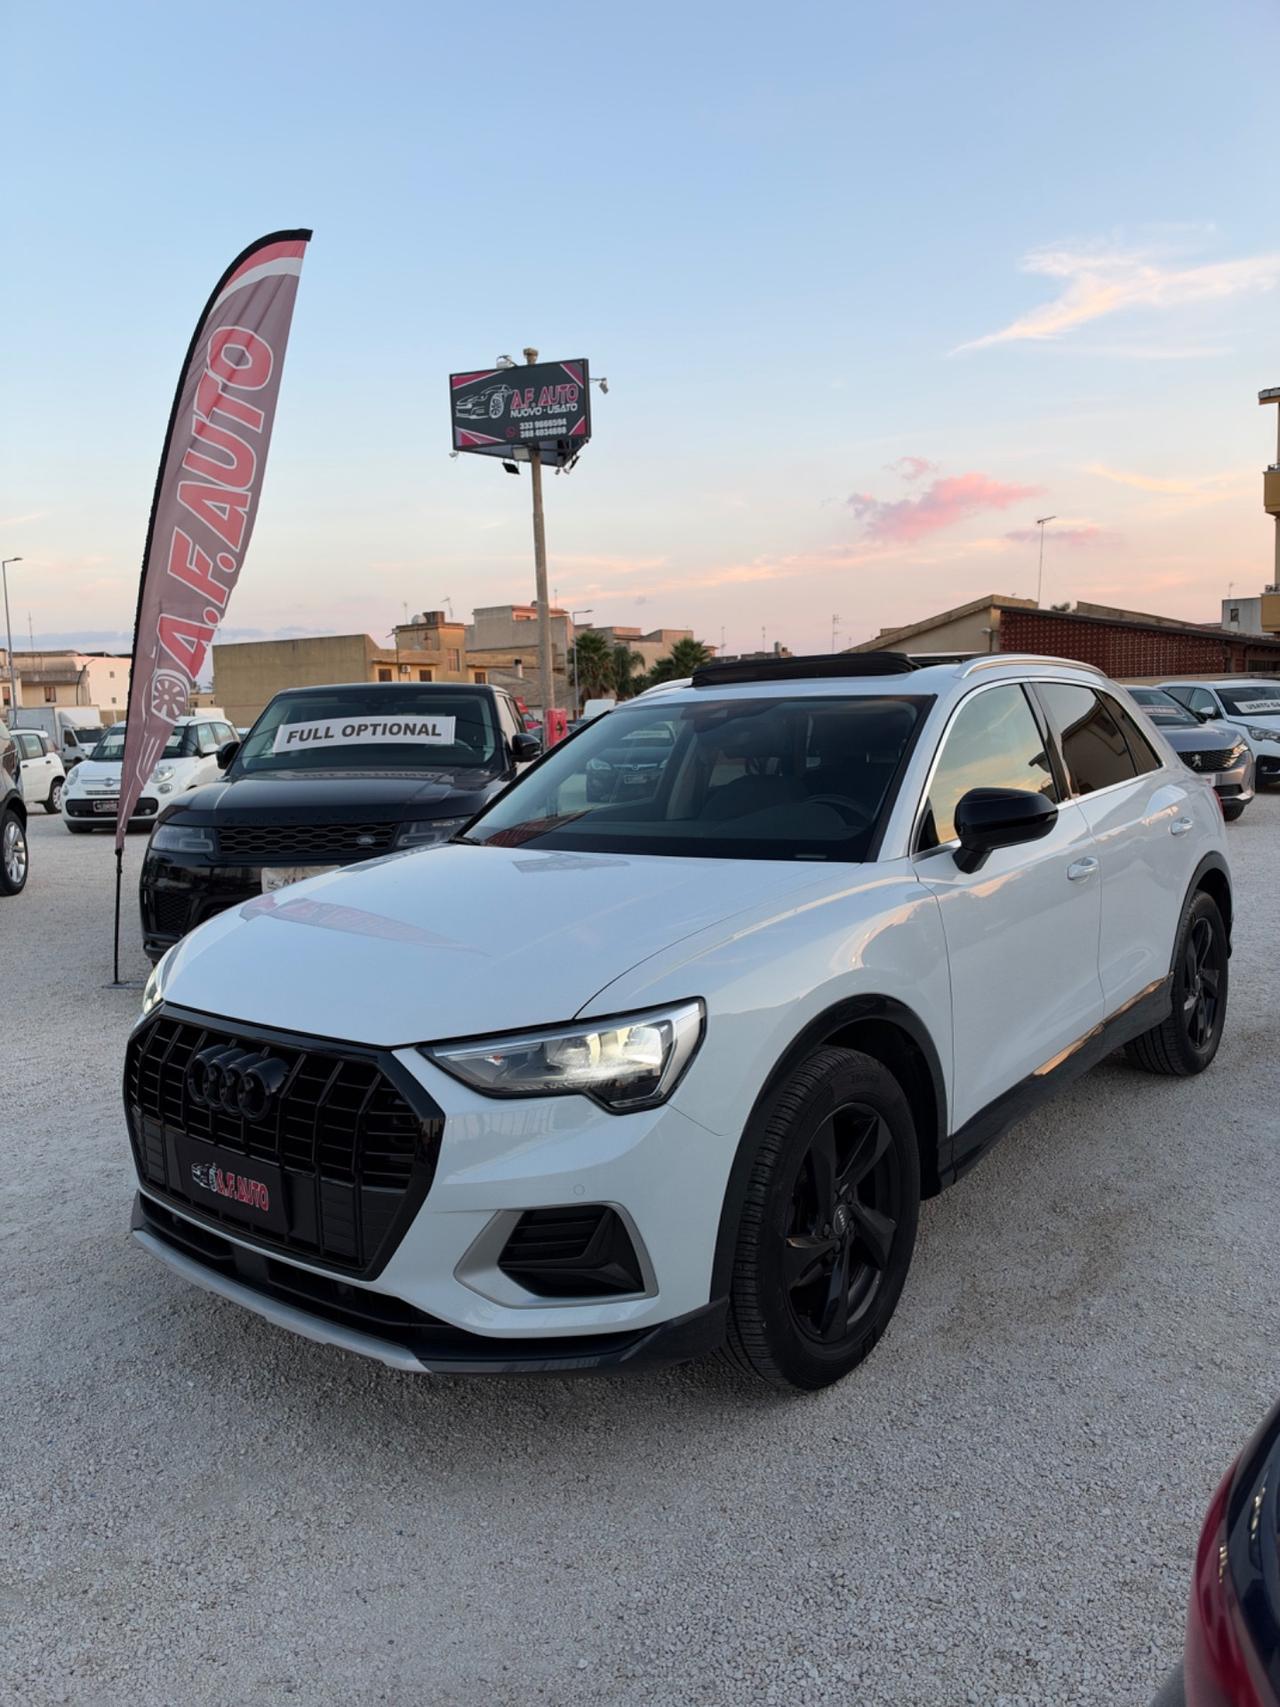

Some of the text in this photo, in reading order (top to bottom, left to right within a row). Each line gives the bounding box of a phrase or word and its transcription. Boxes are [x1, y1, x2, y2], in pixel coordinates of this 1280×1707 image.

[511, 403, 577, 418] NUOVO USATO
[286, 723, 442, 744] FULL OPTIONAL
